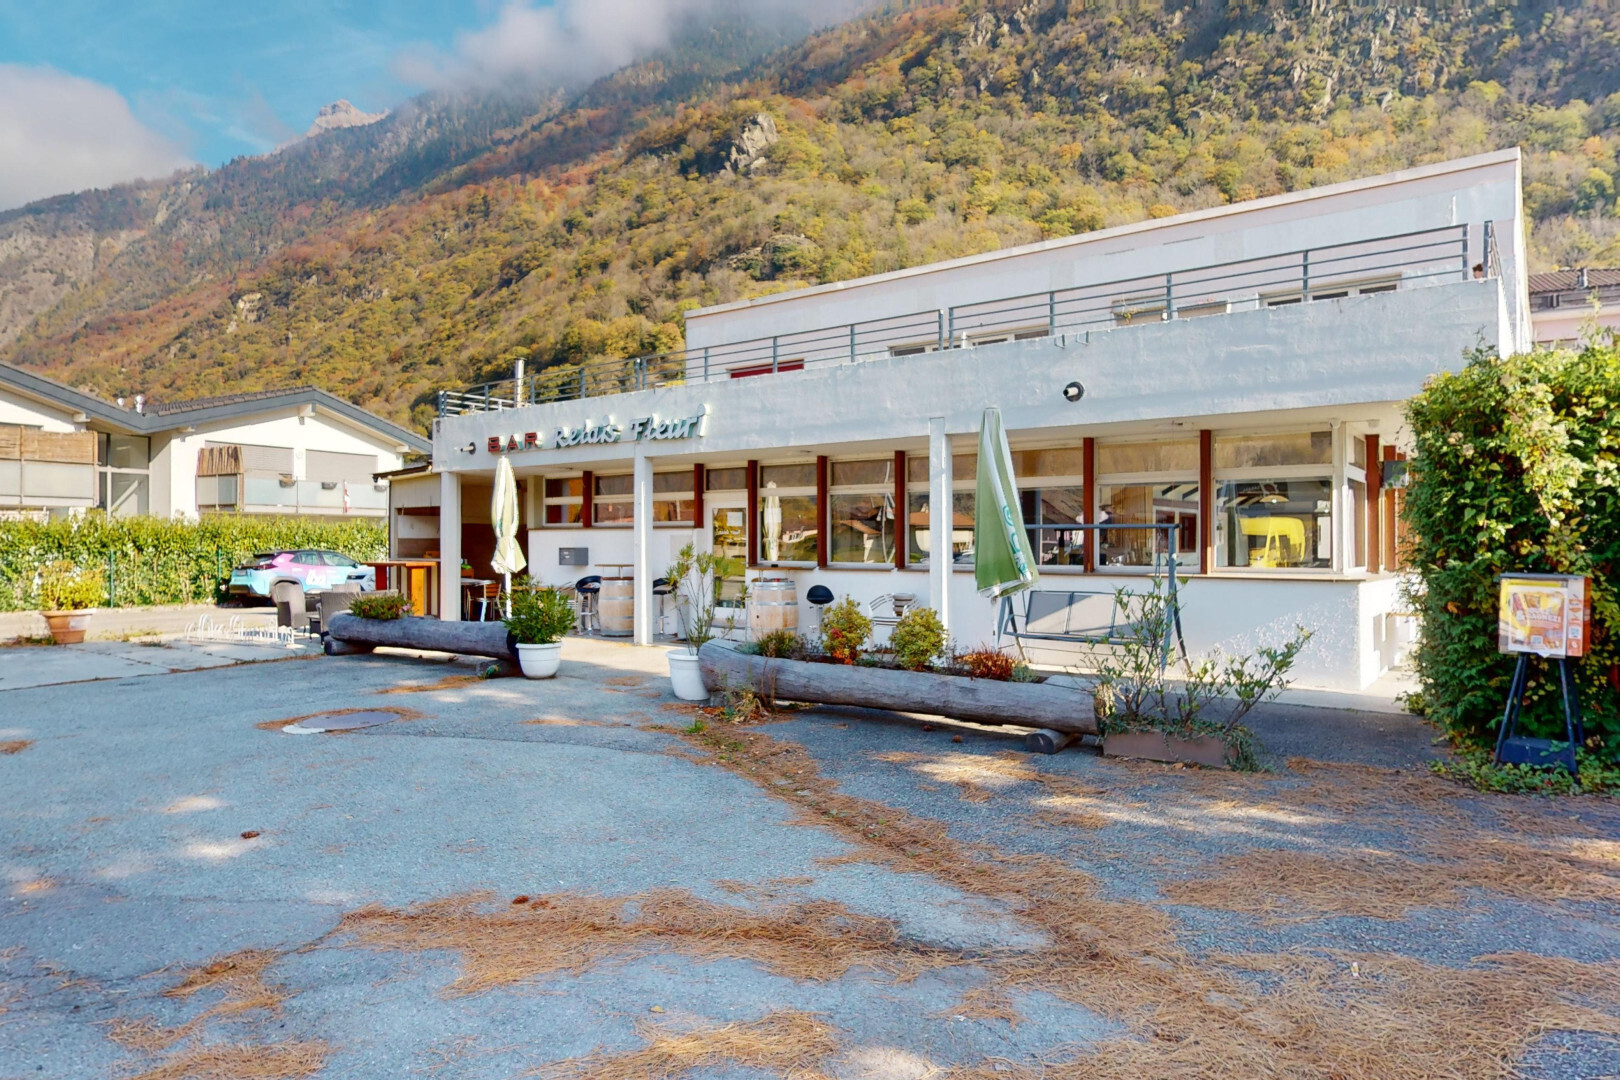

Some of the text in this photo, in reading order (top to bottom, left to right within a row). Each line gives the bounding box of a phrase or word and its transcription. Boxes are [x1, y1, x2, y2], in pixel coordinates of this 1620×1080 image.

[487, 403, 710, 453] BAR Relais Fleuri
